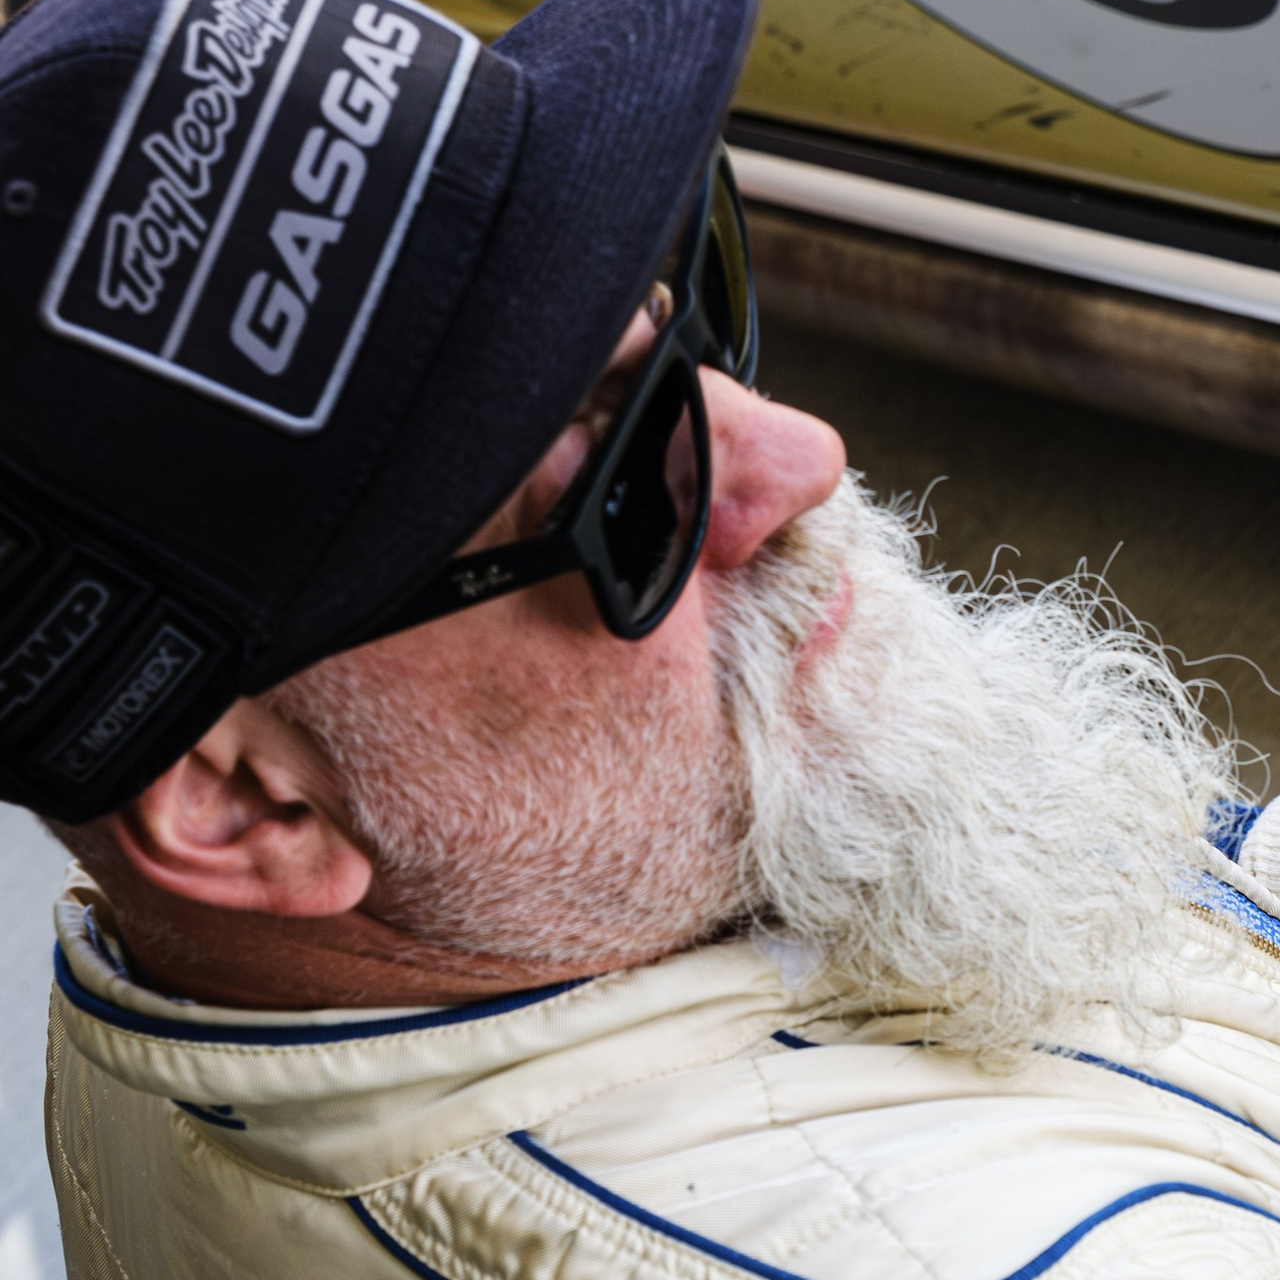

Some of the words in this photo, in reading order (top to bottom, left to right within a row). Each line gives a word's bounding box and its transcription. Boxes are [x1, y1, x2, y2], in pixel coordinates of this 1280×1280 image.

[141, 84, 236, 198] Lee
[230, 1, 421, 376] GASGAS
[97, 177, 207, 313] Troy
